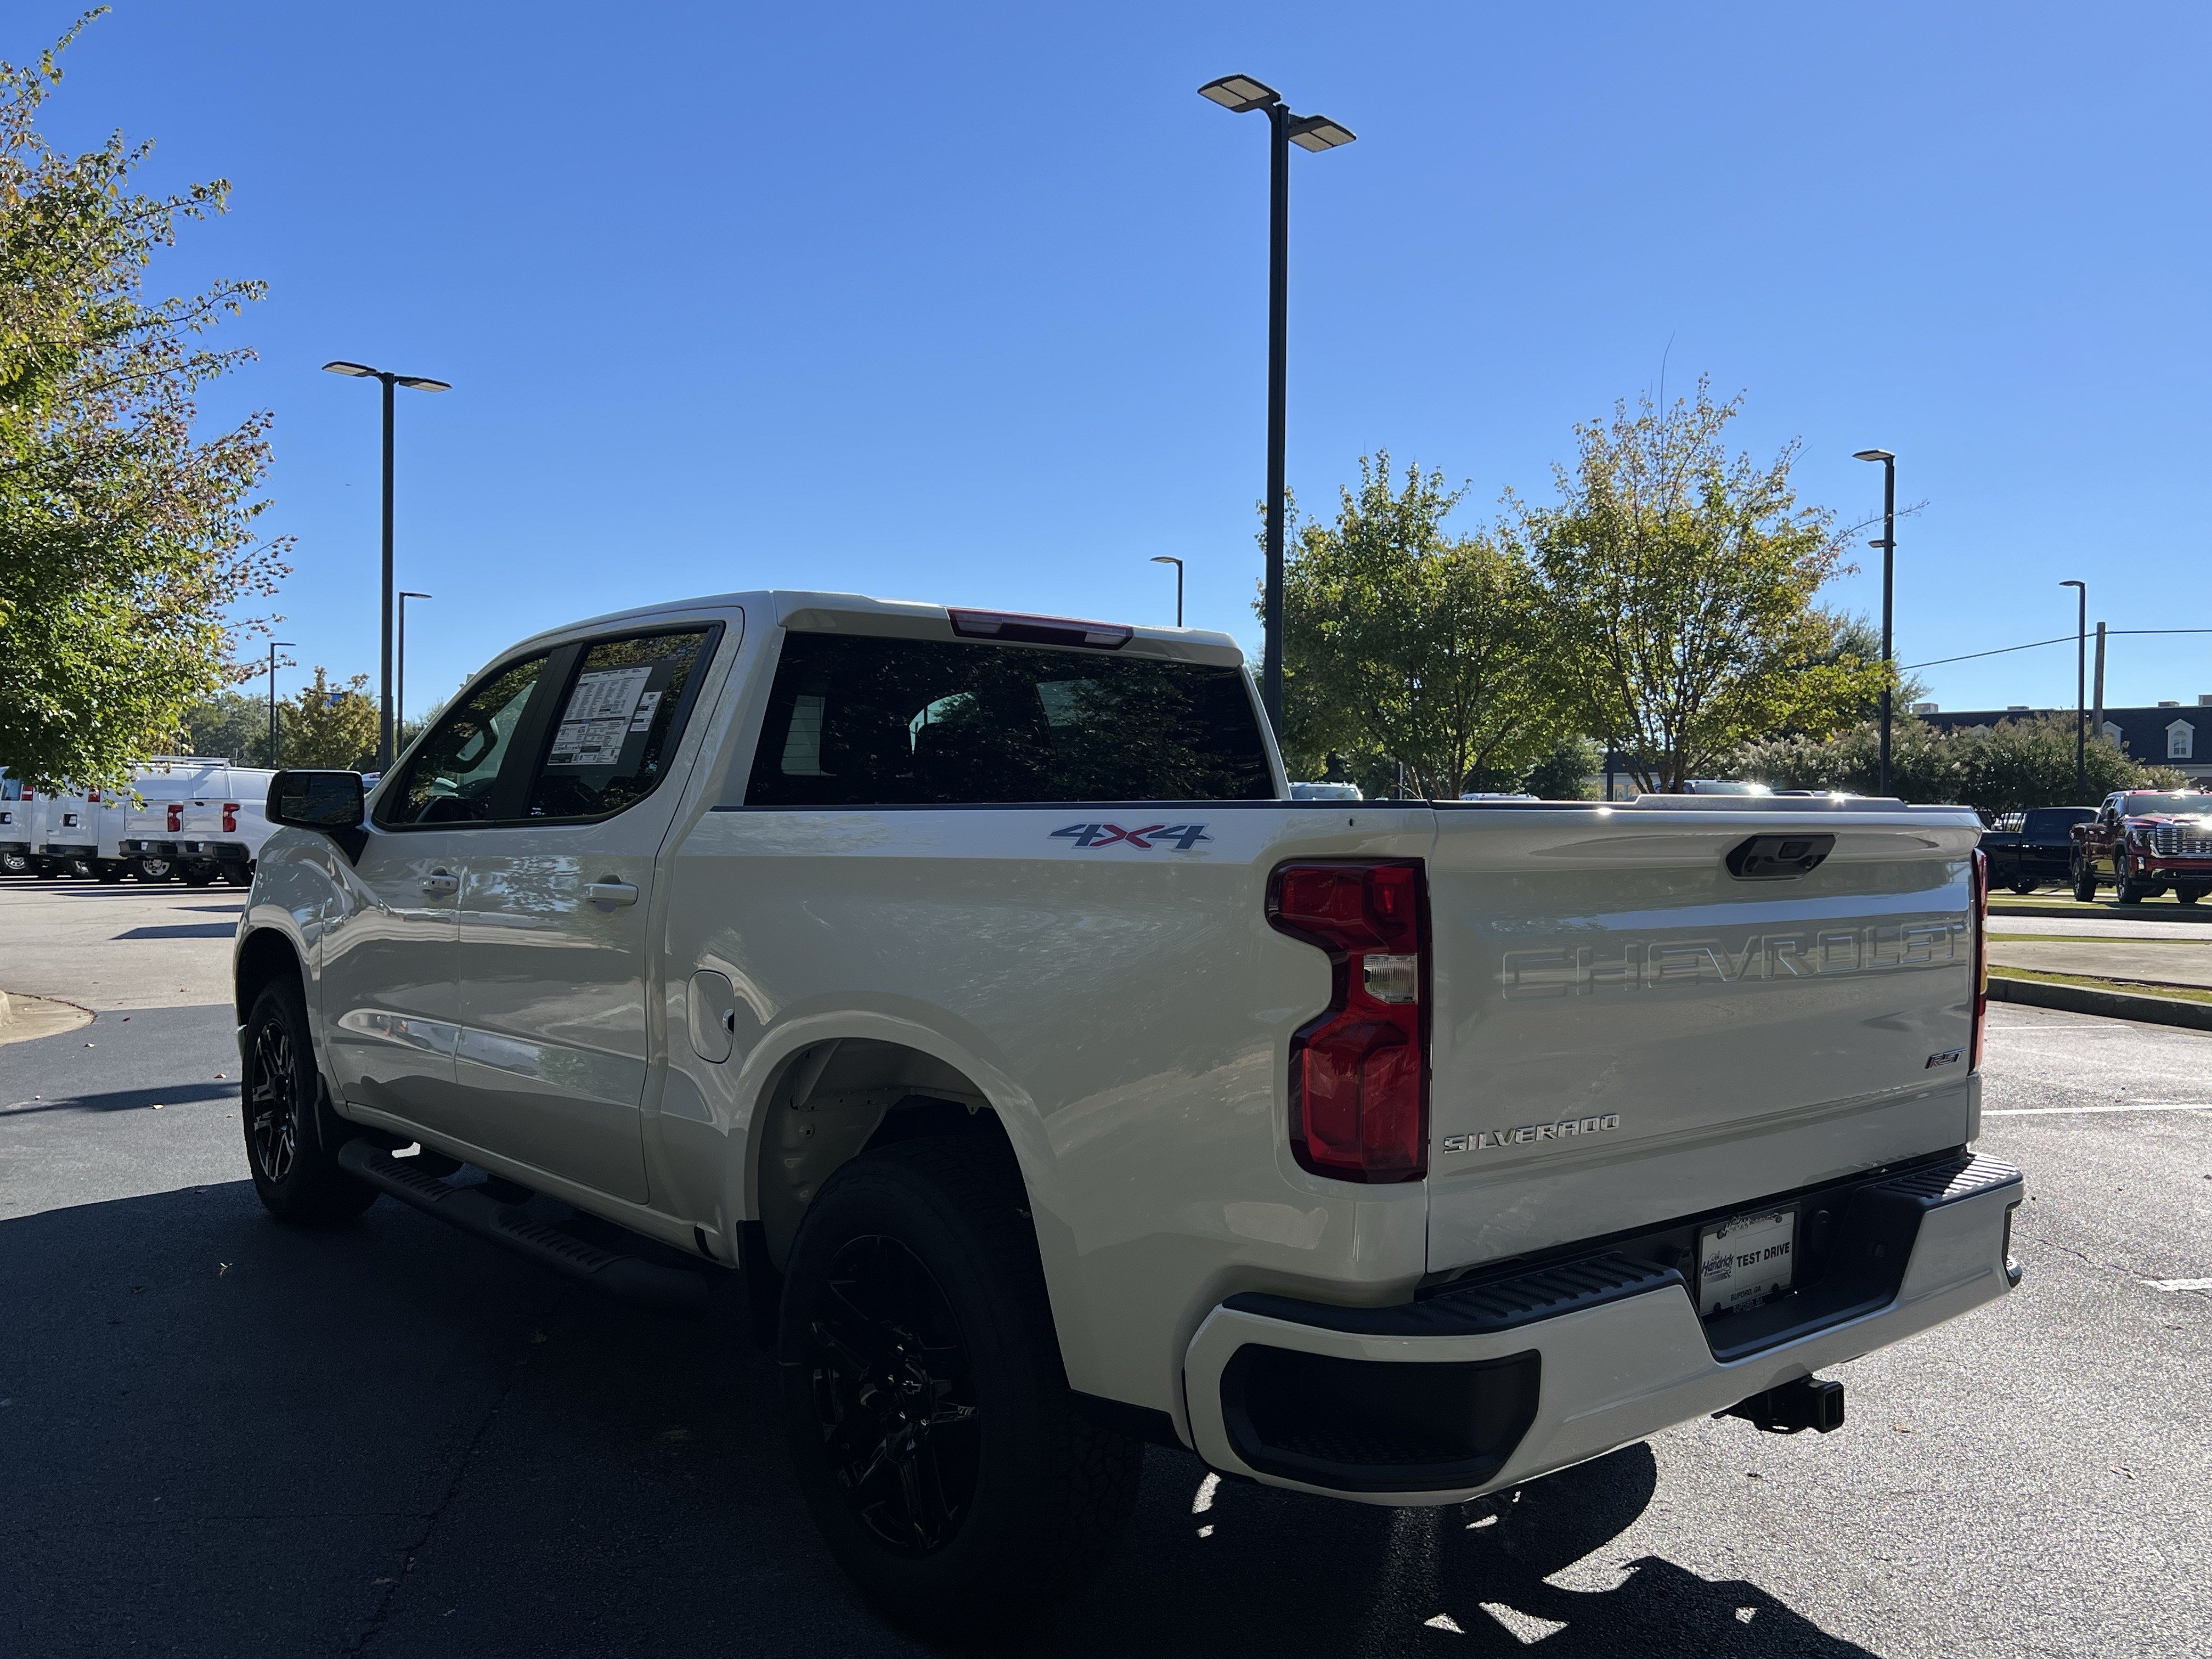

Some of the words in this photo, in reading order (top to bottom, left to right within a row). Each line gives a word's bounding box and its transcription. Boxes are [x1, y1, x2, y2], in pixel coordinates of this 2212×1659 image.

[1502, 918, 1967, 1001] CHEVROLET
[1925, 1047, 1967, 1069] RST
[1443, 1113, 1620, 1154] SILVERADO
[1736, 1250, 1762, 1268] TEST
[1764, 1242, 1790, 1261] DRIVE
[1754, 1285, 1762, 1294] GA
